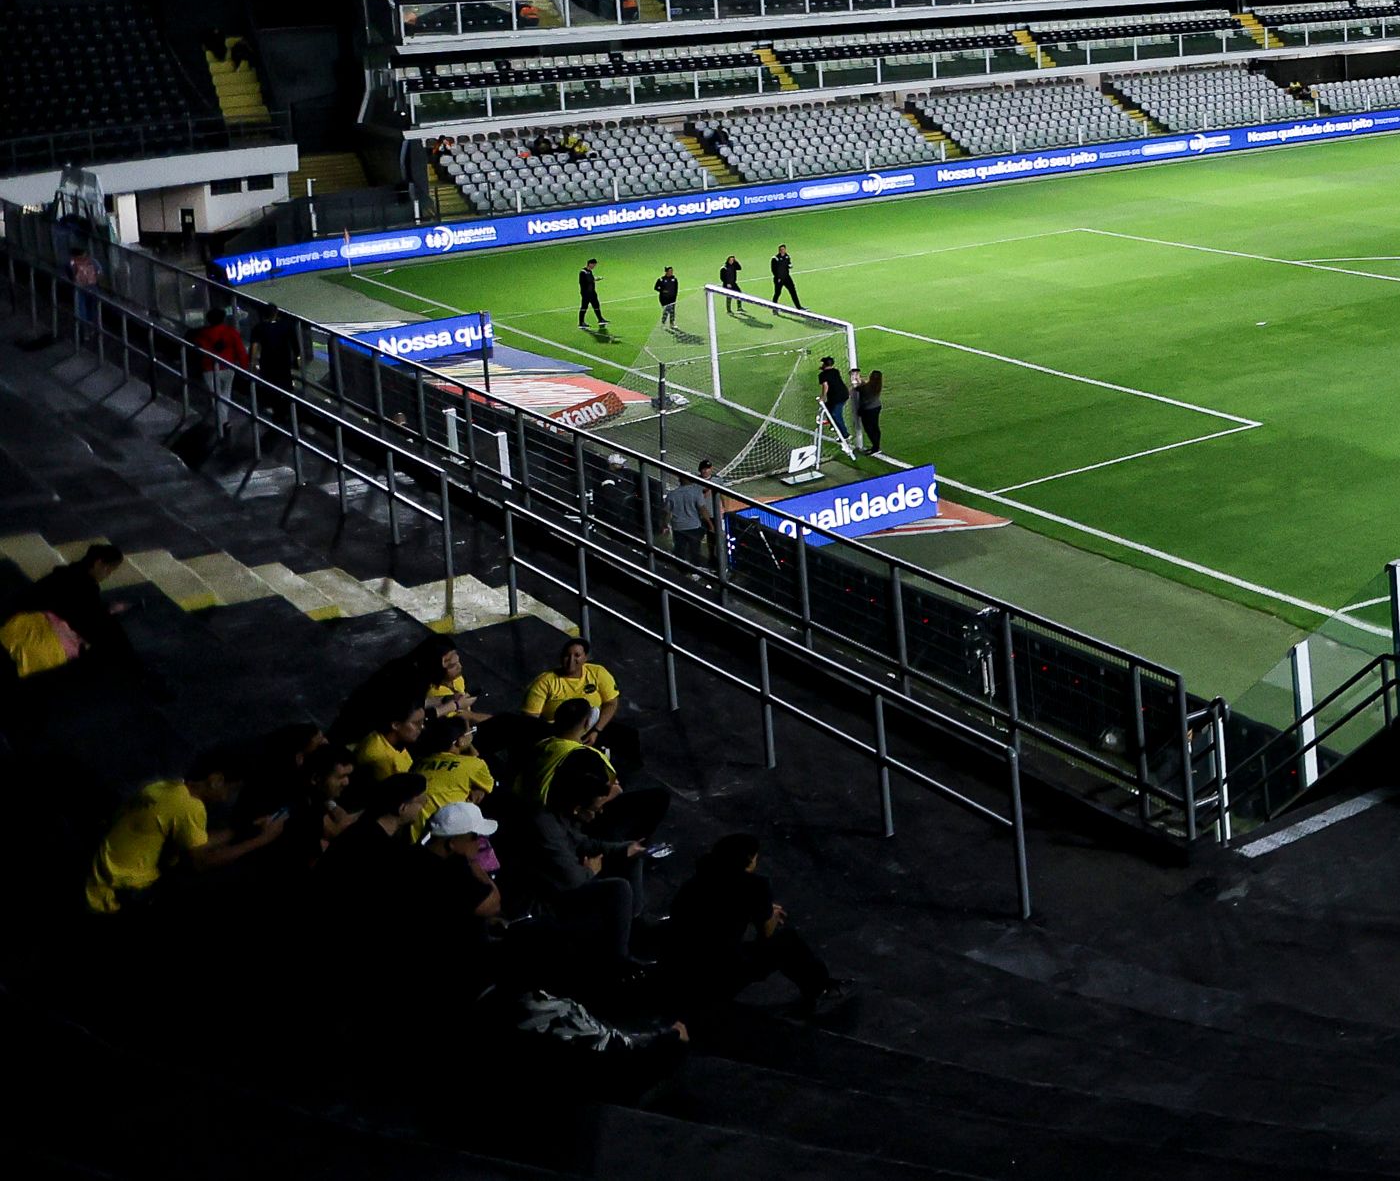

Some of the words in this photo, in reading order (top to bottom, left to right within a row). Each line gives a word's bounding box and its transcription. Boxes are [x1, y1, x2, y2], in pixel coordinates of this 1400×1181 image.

[1247, 130, 1277, 143] Nossa
[1278, 123, 1322, 141] qualidade
[1323, 122, 1336, 133] do
[937, 168, 976, 182] Nossa
[976, 158, 1032, 179] qualidade
[1033, 156, 1049, 169] do
[1050, 154, 1071, 167] seu
[1069, 151, 1097, 167] jeito
[528, 216, 579, 235] Nossa
[580, 206, 655, 231] qualidade
[657, 203, 677, 218] do
[678, 201, 706, 215] seu
[704, 196, 740, 215] jeito
[236, 255, 272, 282] jeito
[276, 249, 338, 267] Inscreva-se
[378, 327, 452, 357] Nossa
[778, 482, 925, 540] qualidade
